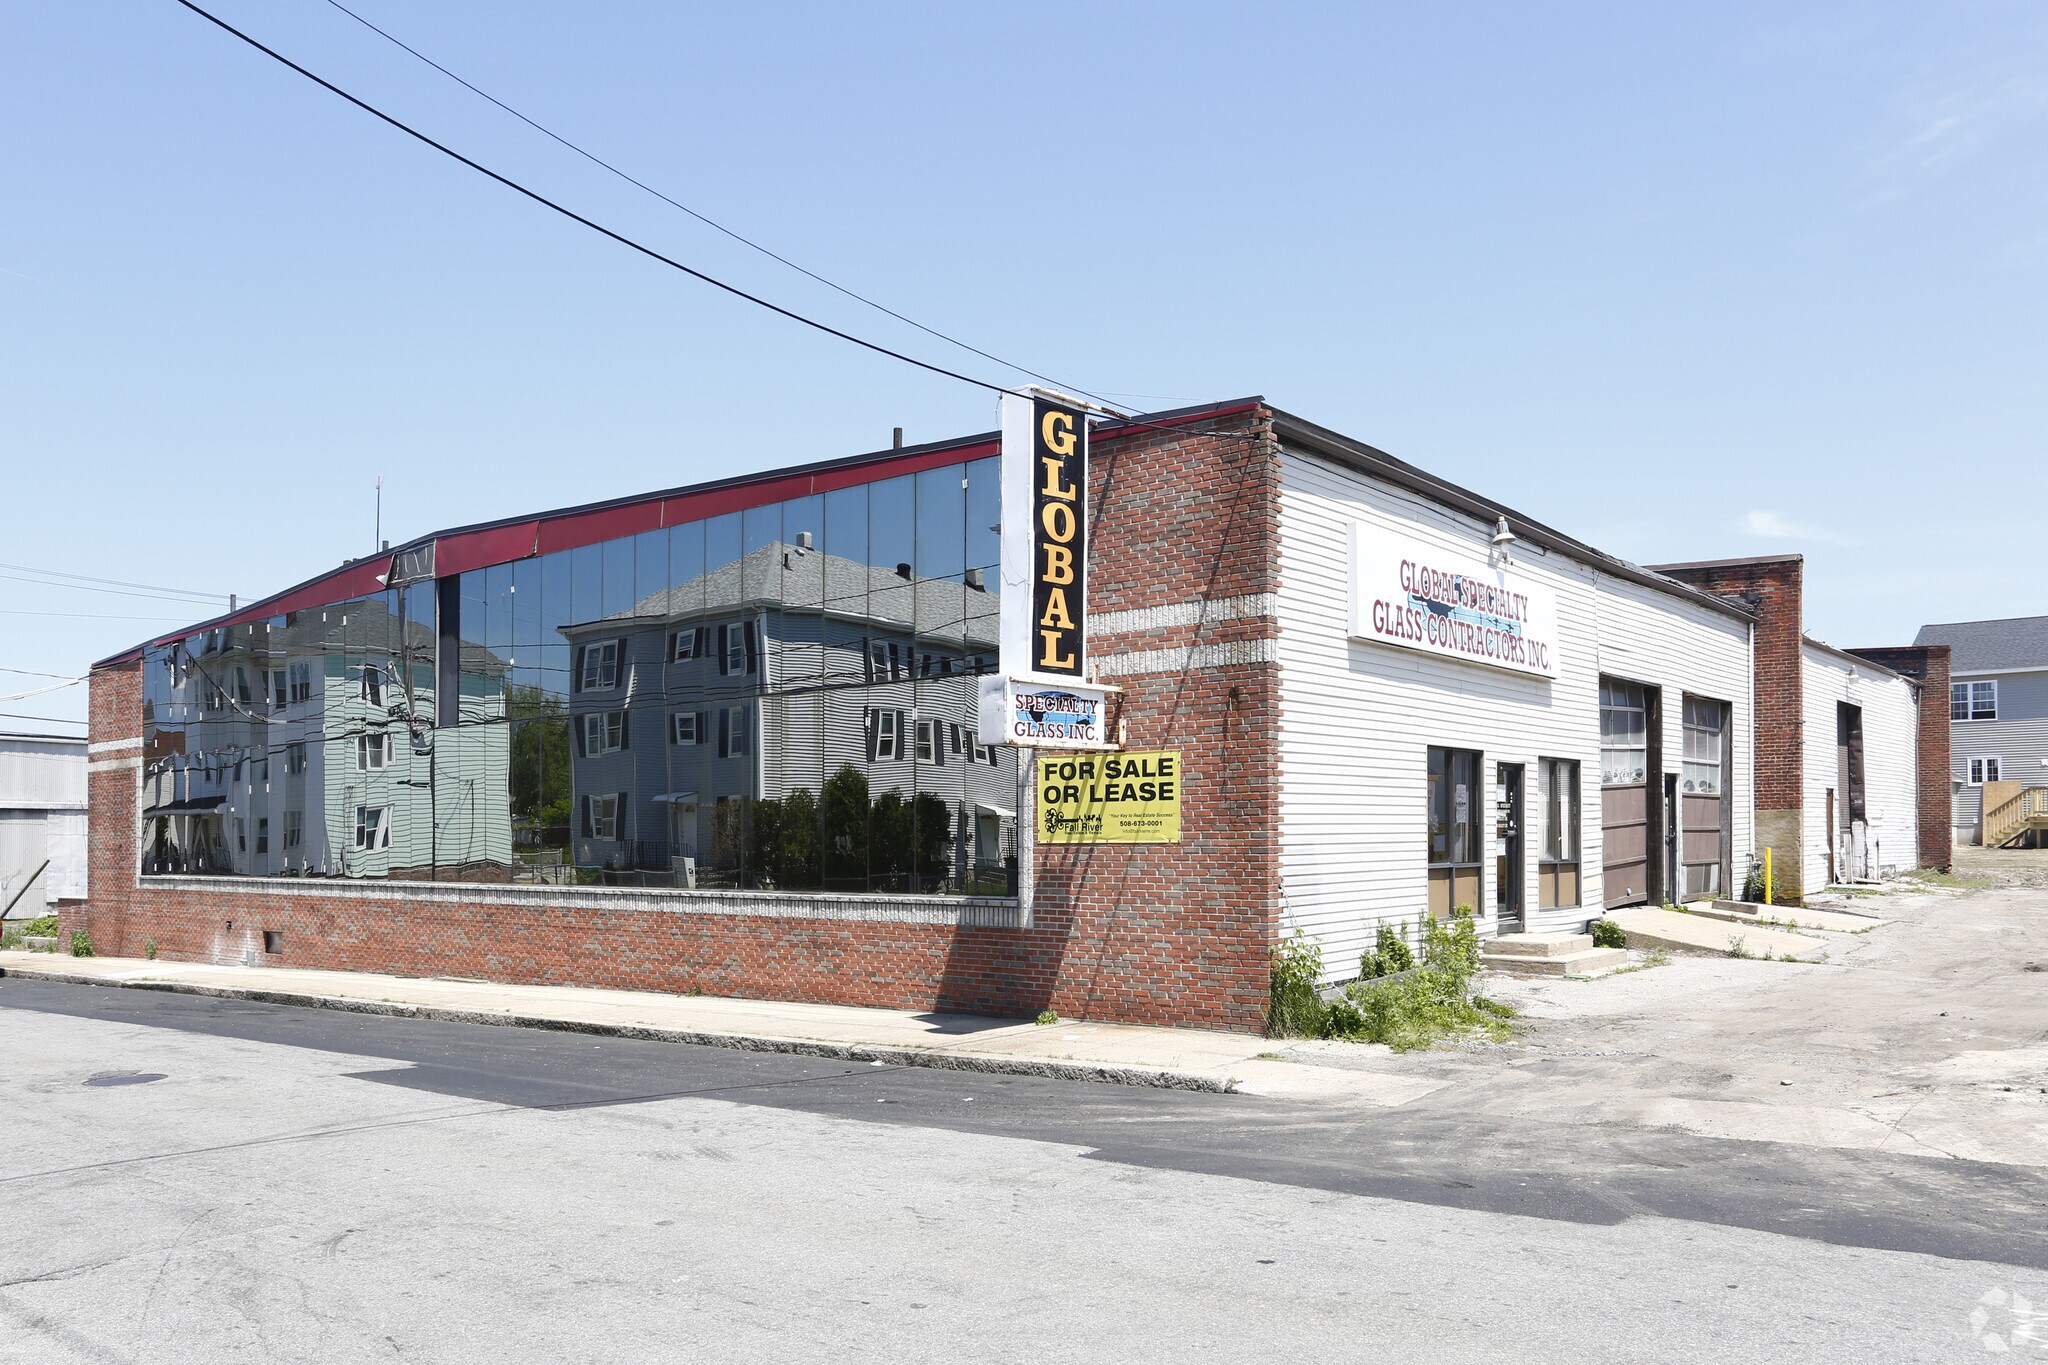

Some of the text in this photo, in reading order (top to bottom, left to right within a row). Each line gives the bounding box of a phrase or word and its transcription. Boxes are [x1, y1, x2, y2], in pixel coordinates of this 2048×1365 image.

[1040, 410, 1077, 669] GLOBAL
[1400, 559, 1528, 623] GLOBAL SPECIALTY
[1373, 599, 1552, 670] GLASS CONTRACTORS INC.
[1016, 694, 1098, 714] SPECIALTY
[1014, 721, 1099, 741] GLASS INC.
[1044, 758, 1174, 781] FOR SALE
[1044, 782, 1174, 804] OR LEASE
[1064, 822, 1103, 832] Fall River
